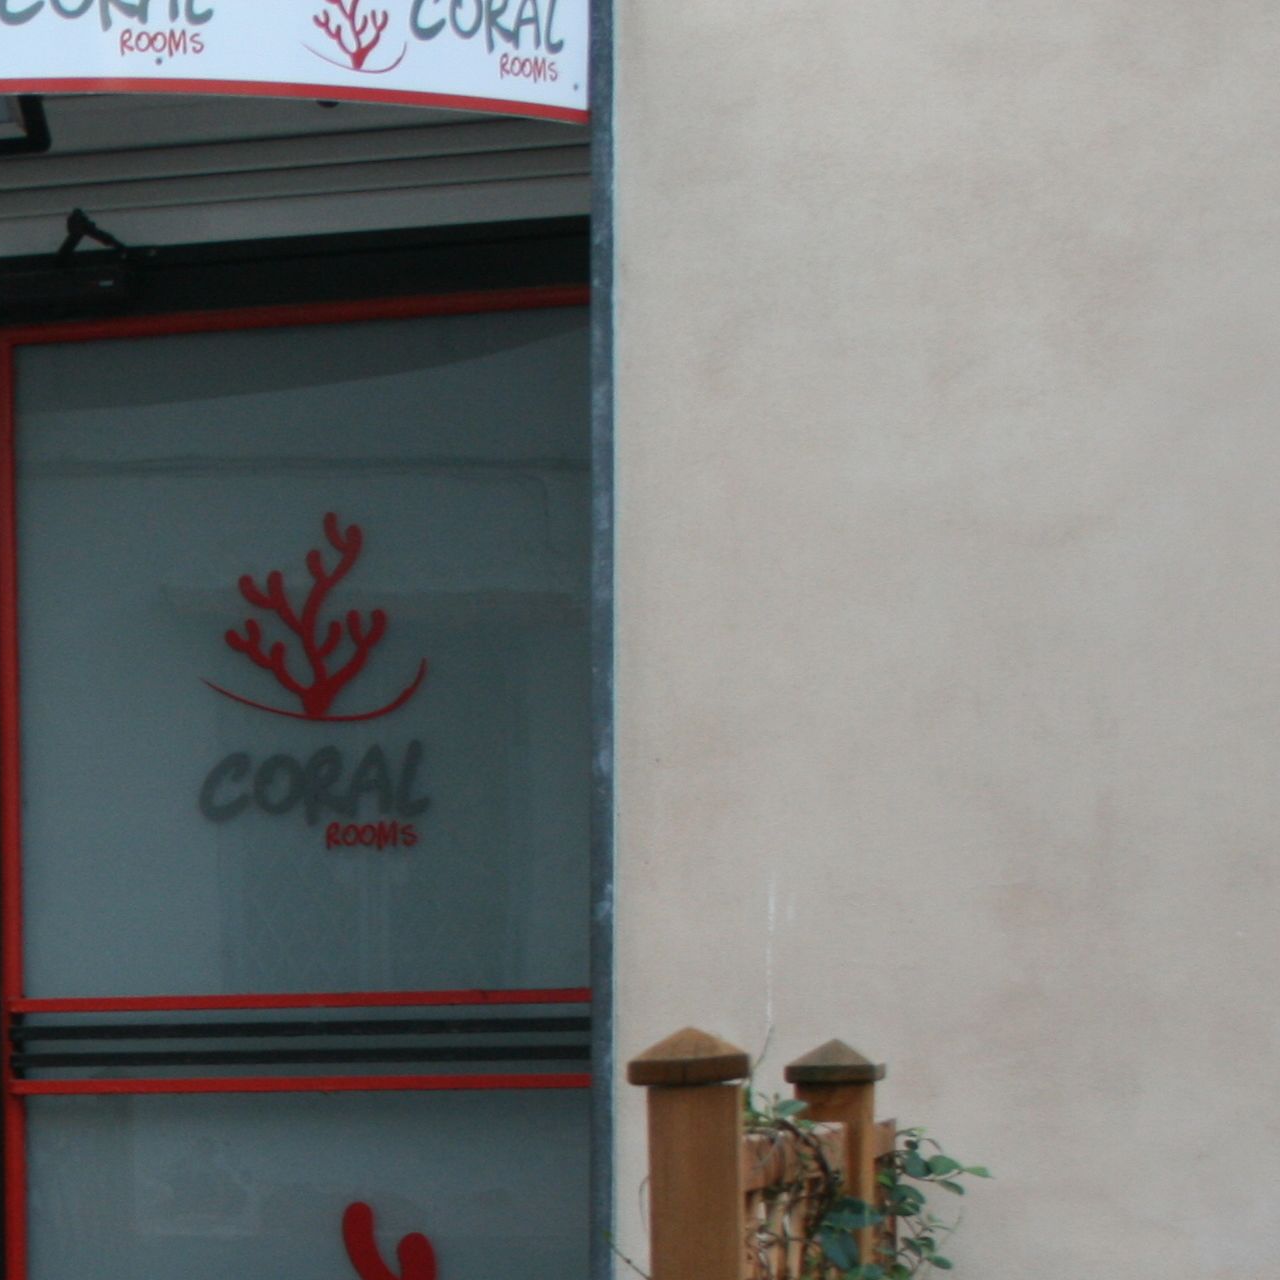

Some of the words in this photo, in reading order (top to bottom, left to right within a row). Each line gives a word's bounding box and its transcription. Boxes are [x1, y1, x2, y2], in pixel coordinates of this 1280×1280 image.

[120, 28, 205, 57] ROOMS
[409, 0, 564, 54] CORAL
[500, 53, 559, 83] ROOMS
[197, 738, 433, 827] CORAL
[324, 819, 421, 851] ROOMS
